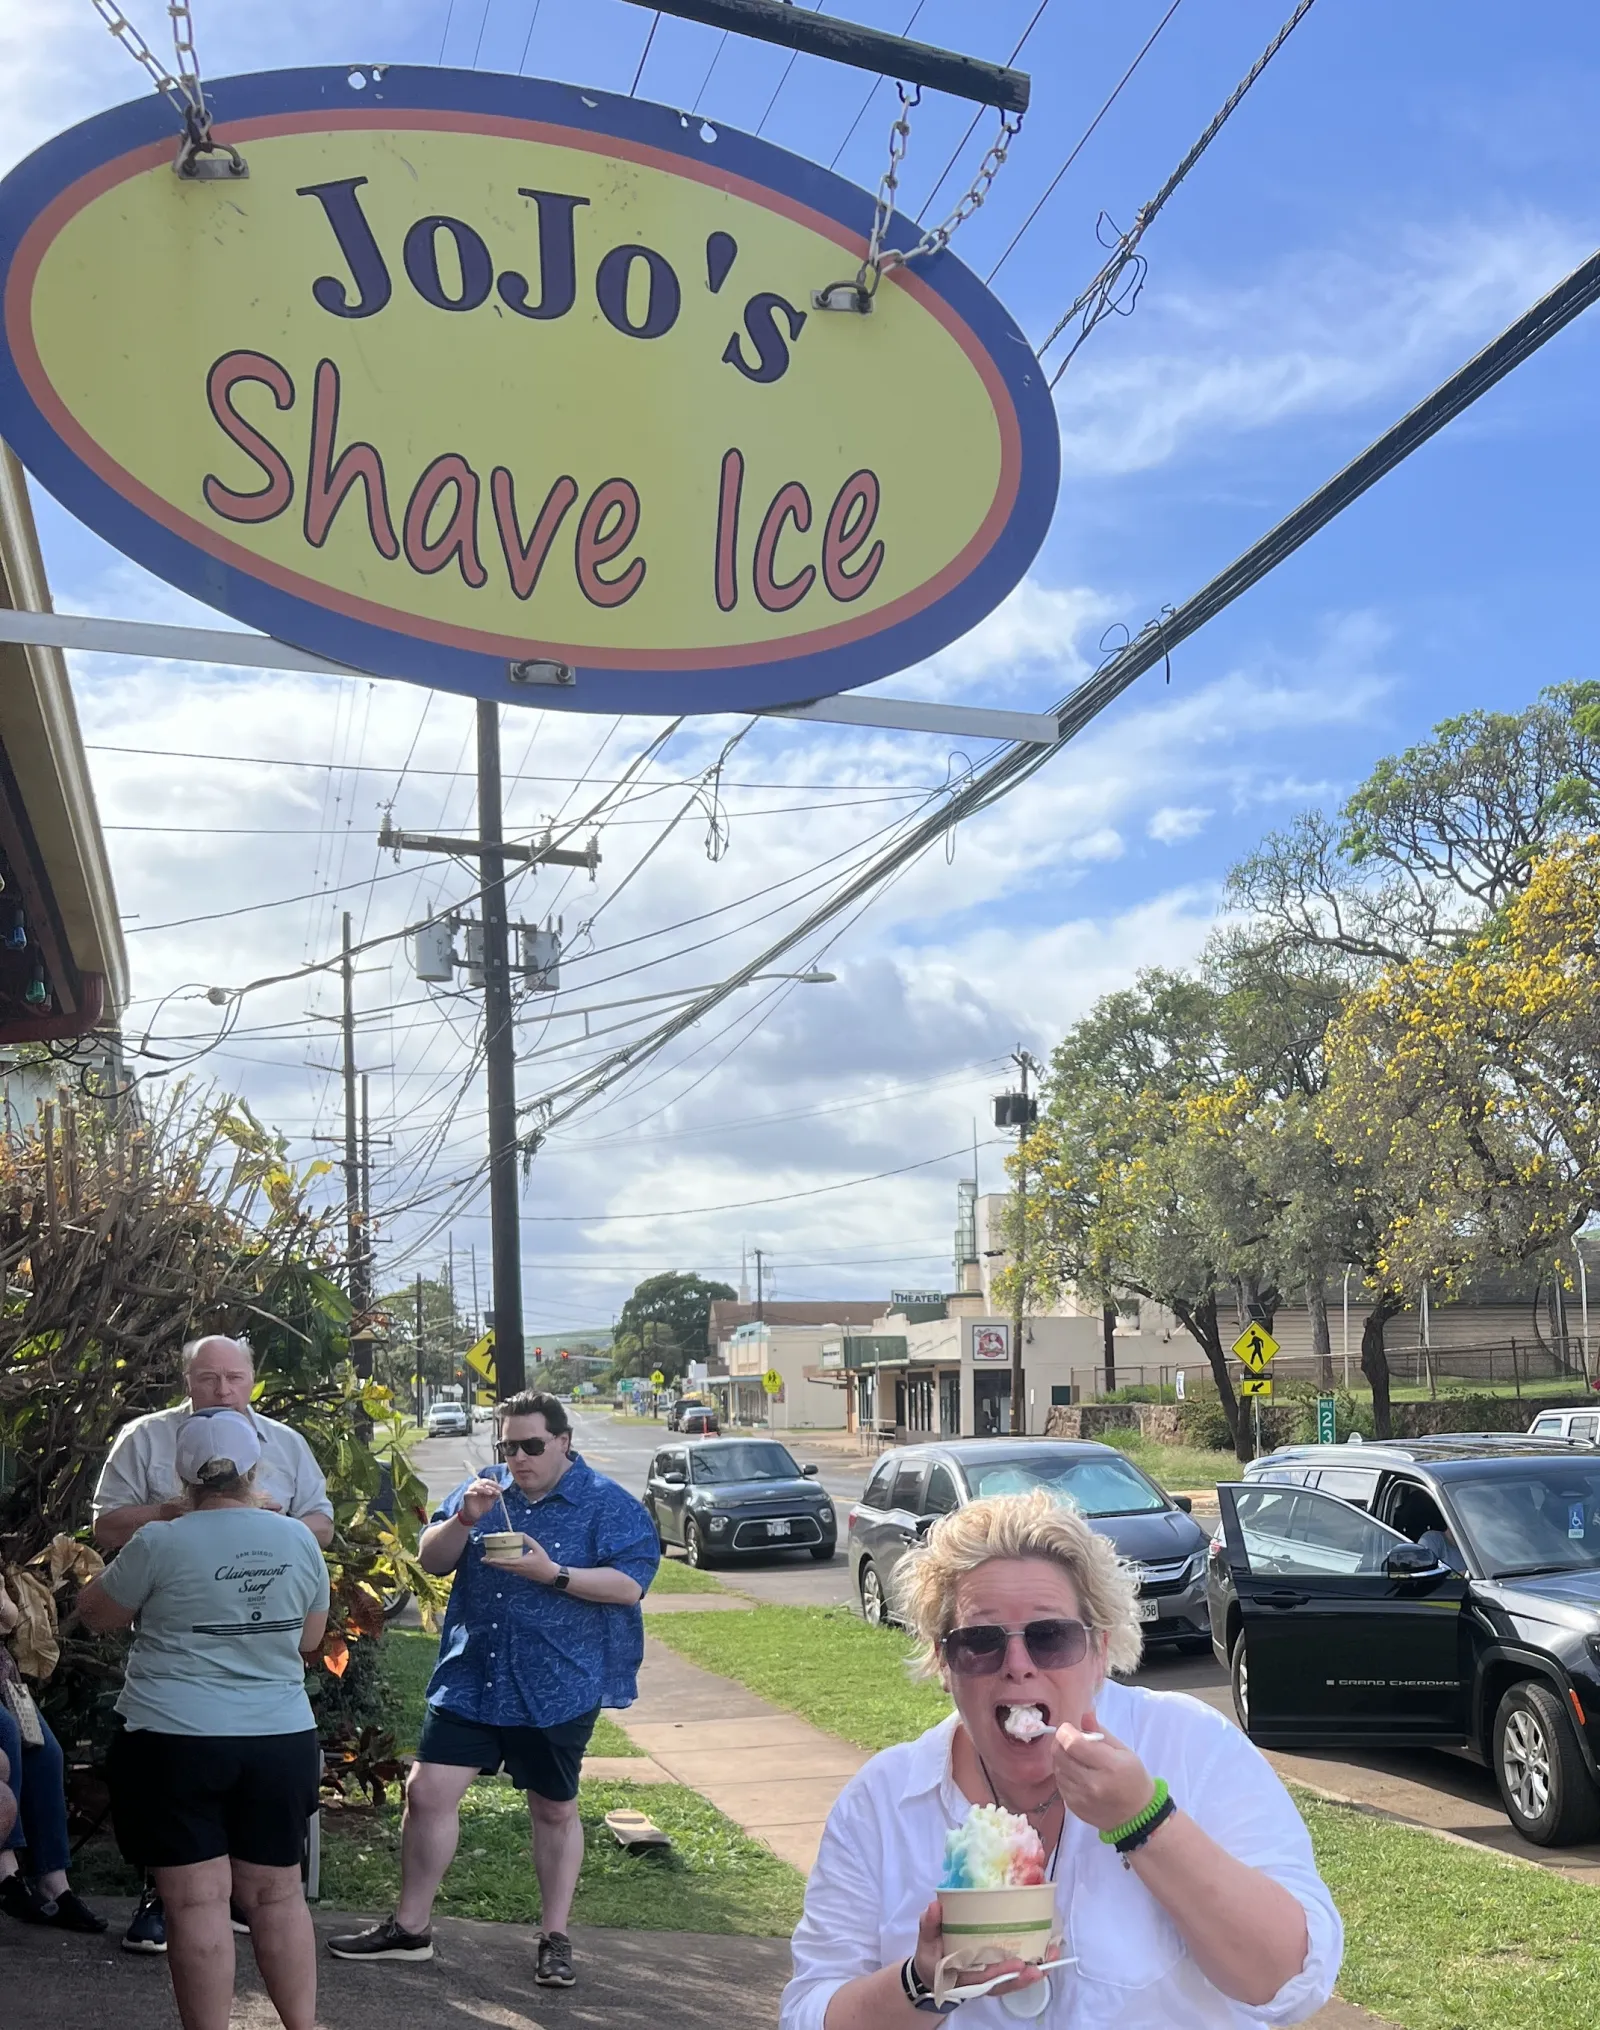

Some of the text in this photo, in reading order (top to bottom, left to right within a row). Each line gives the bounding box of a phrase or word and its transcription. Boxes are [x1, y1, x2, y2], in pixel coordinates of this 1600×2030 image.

[296, 176, 807, 383] JoJo's
[202, 350, 885, 612] Shave Ice
[894, 1293, 940, 1303] THEATER
[251, 1550, 274, 1558] DIEGO
[214, 1563, 293, 1581] Clairemont
[238, 1577, 275, 1595] Surf
